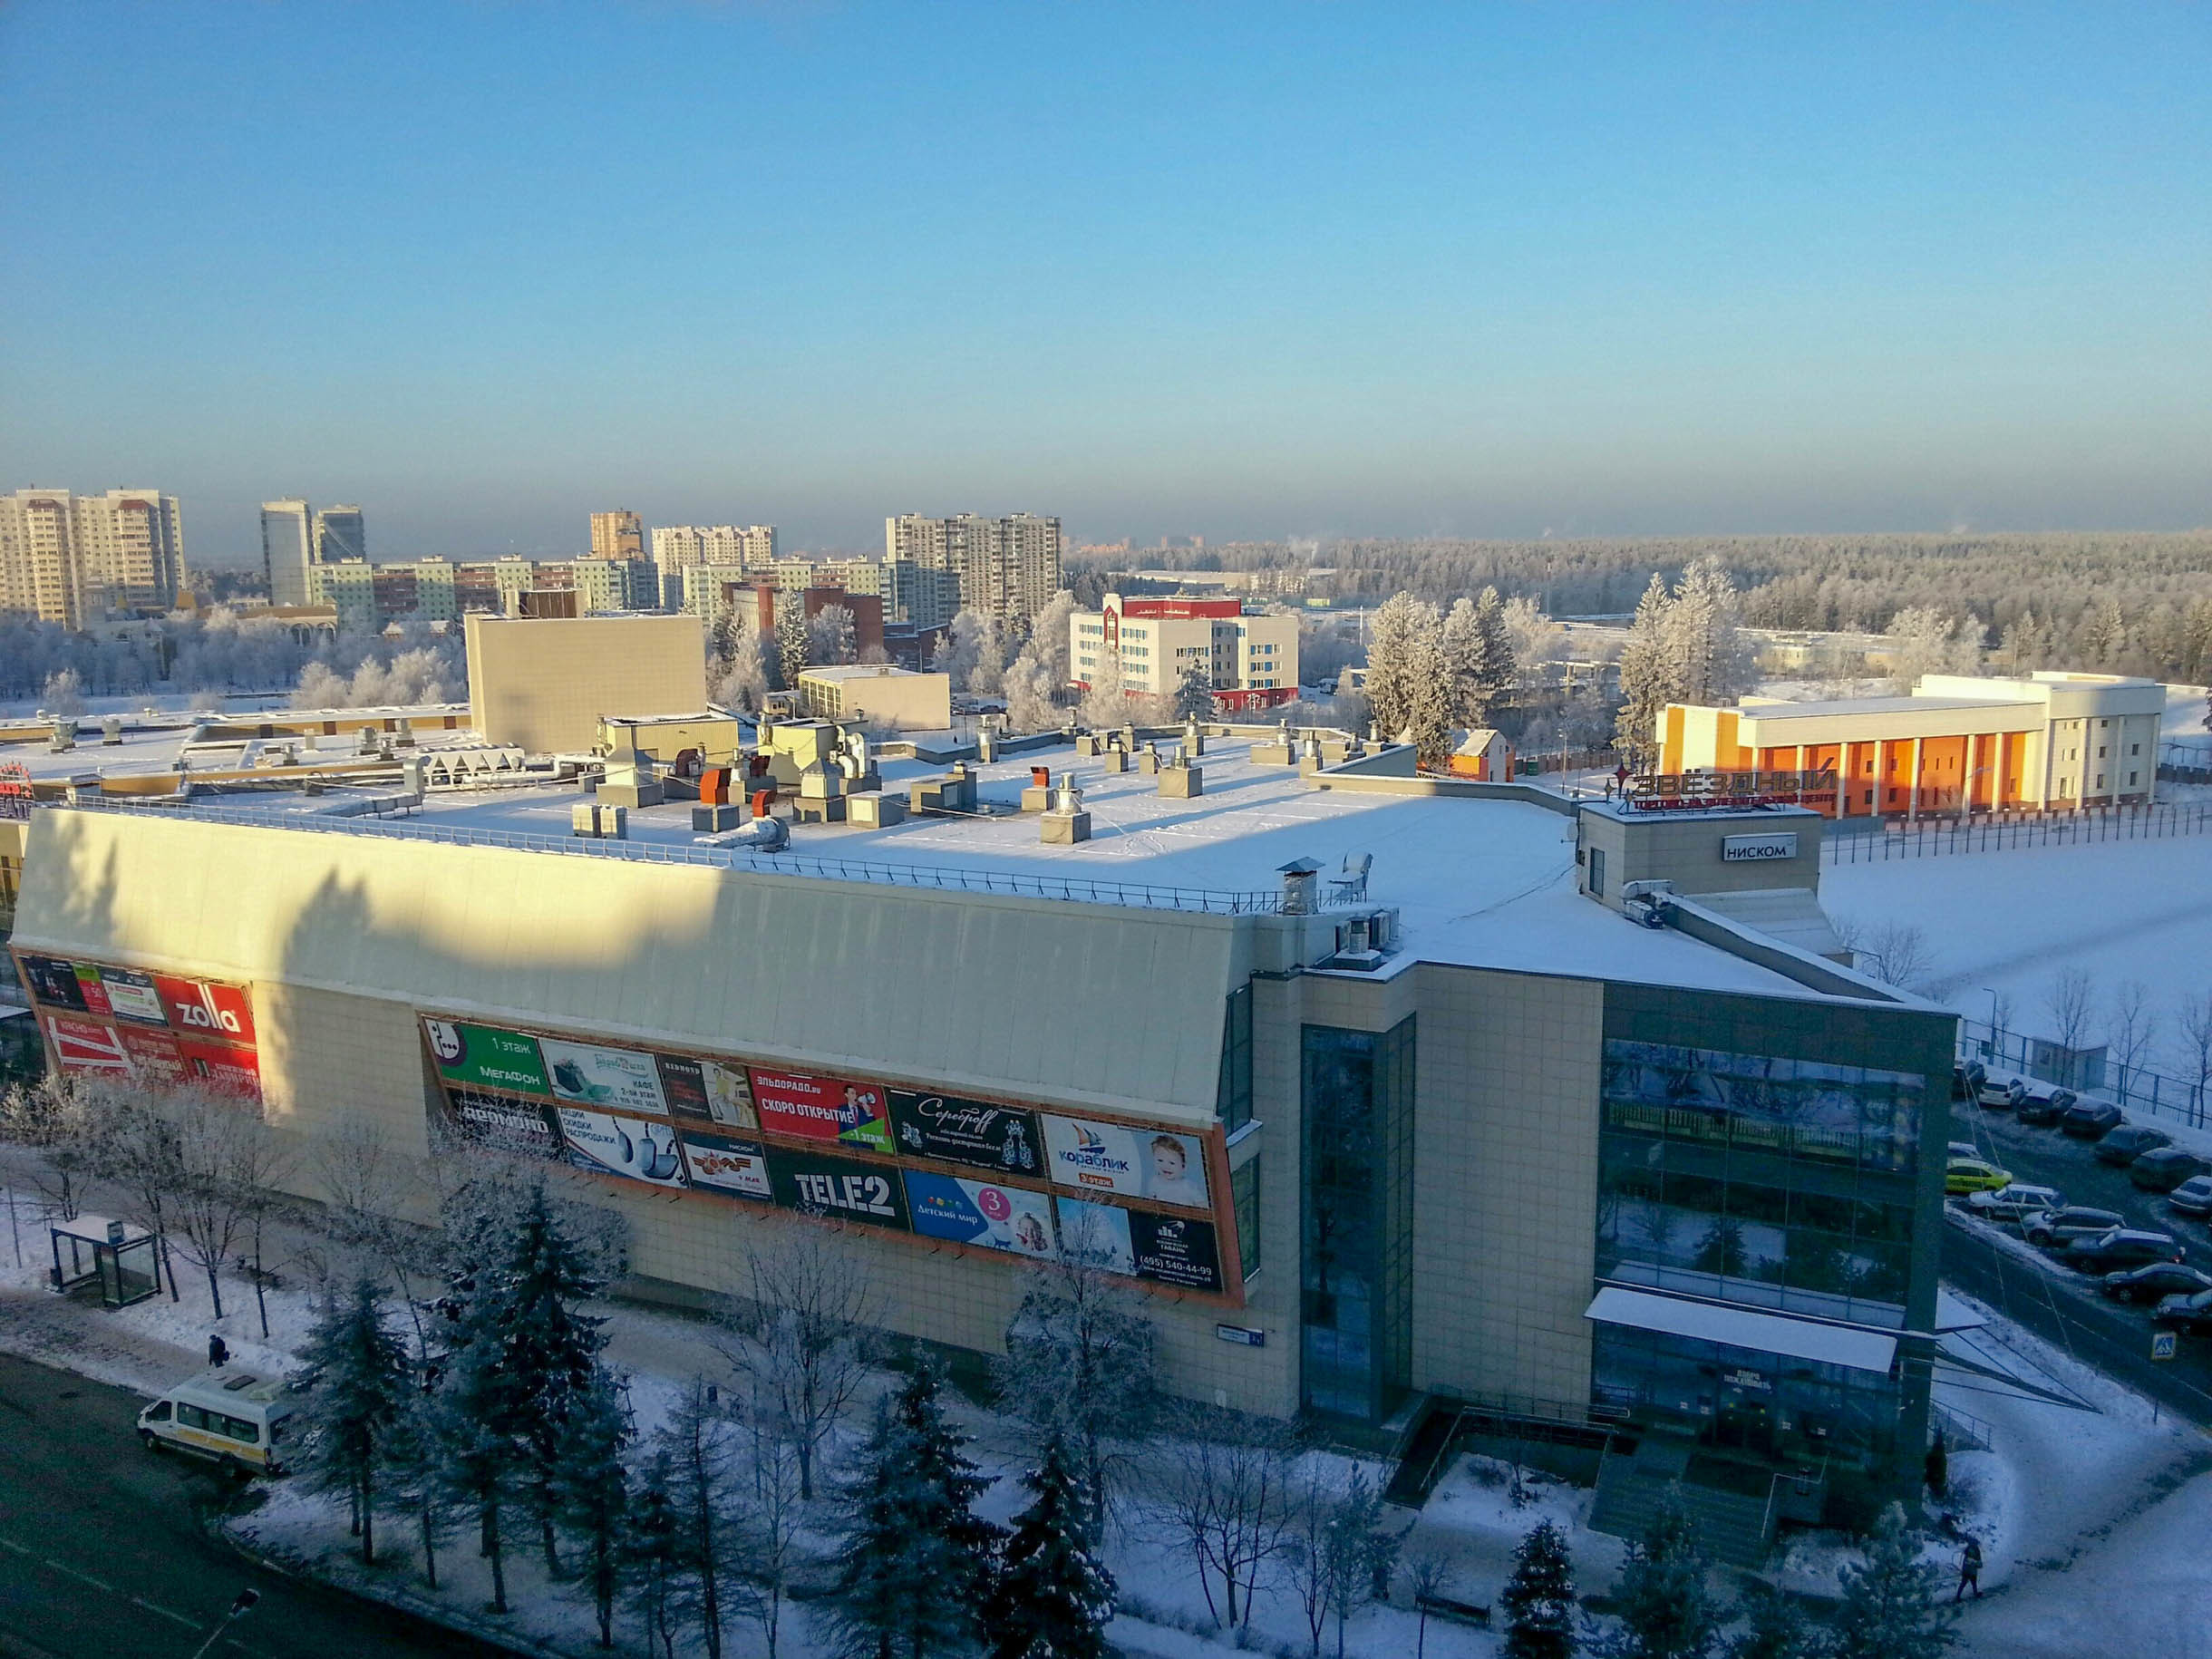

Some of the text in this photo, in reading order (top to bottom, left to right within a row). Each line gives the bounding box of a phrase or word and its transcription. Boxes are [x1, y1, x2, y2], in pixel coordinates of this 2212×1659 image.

[1633, 756, 1837, 796] ЗВЁЗДНЫЙ
[1726, 846, 1786, 859] НИСКОМ
[175, 984, 242, 1033] zolla
[492, 1037, 531, 1054] 1 этаж
[665, 1062, 701, 1075] REDMOND
[762, 1097, 796, 1115] СКОРО
[562, 1117, 593, 1130] СКИДКИ
[565, 1128, 616, 1145] РАСПРОДАЖИ
[860, 1132, 886, 1145] этаж
[1058, 1150, 1130, 1172] кораблик
[794, 1173, 896, 1217] TELE2
[985, 1191, 1001, 1211] 3
[917, 1203, 956, 1220] Детский
[958, 1213, 978, 1226] мир
[1140, 1255, 1164, 1268] (495)
[1165, 1259, 1212, 1276] 540-44-99
